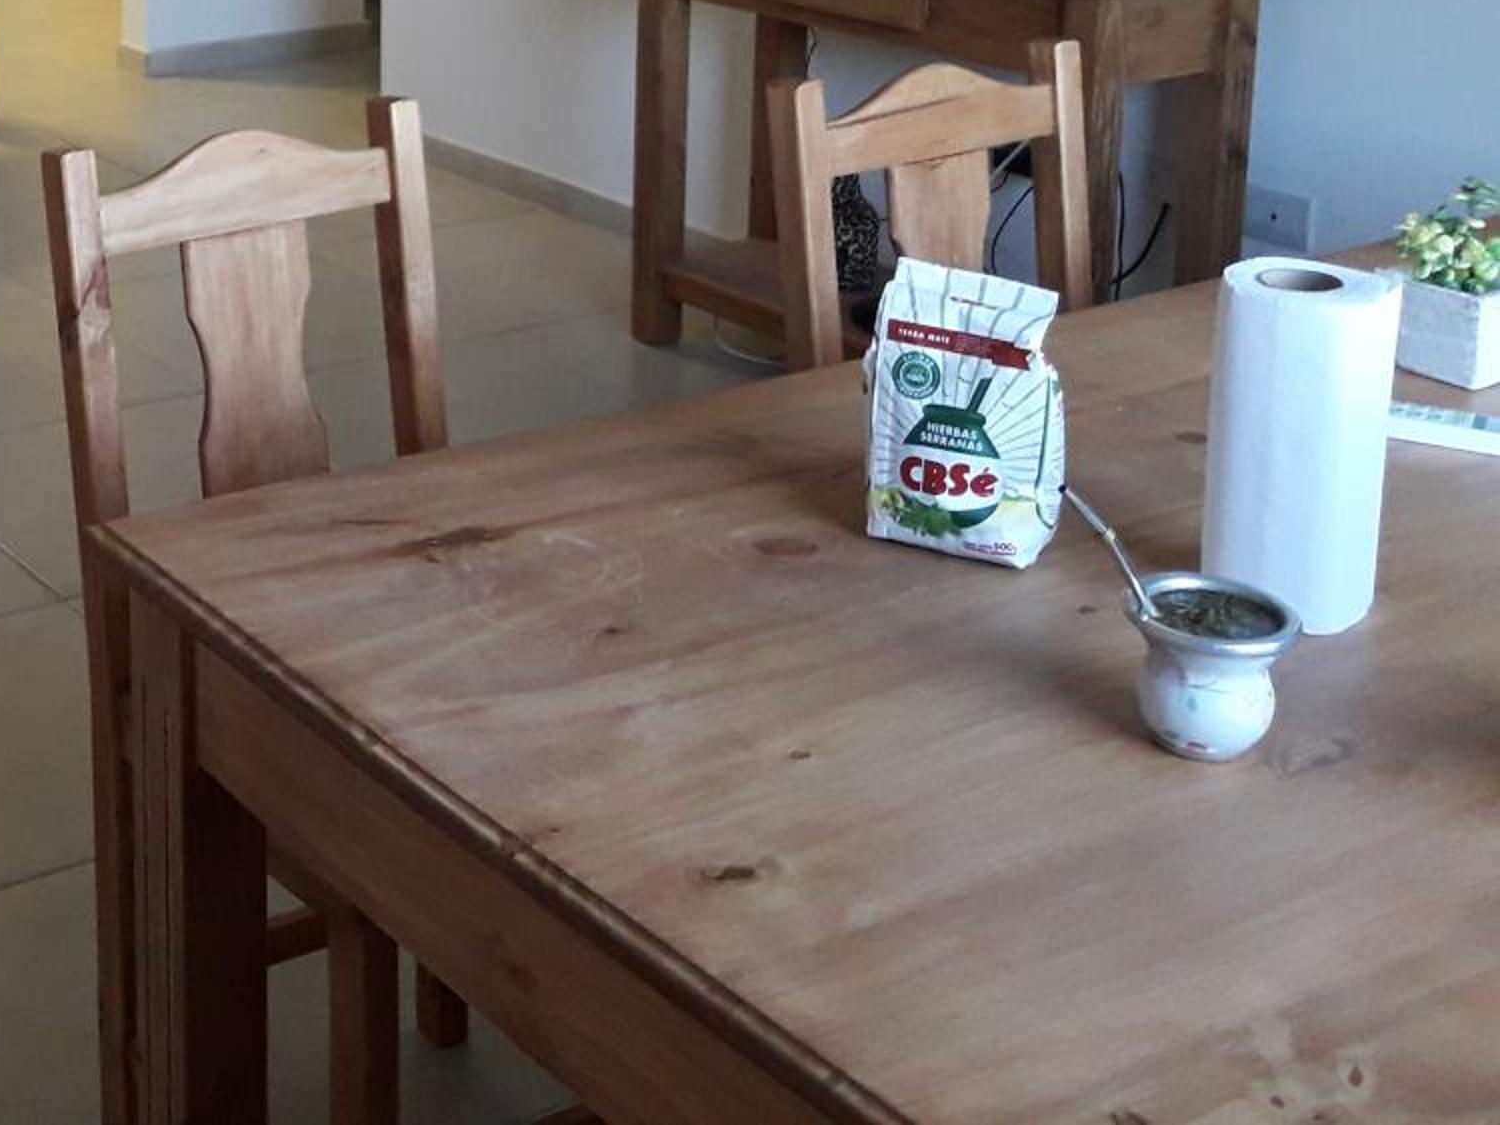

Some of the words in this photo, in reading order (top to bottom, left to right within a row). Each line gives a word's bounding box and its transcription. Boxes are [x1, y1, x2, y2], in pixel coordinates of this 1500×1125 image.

[919, 431, 983, 452] SERRANAS
[927, 421, 979, 441] HIERBAS
[899, 456, 998, 498] CBSé
